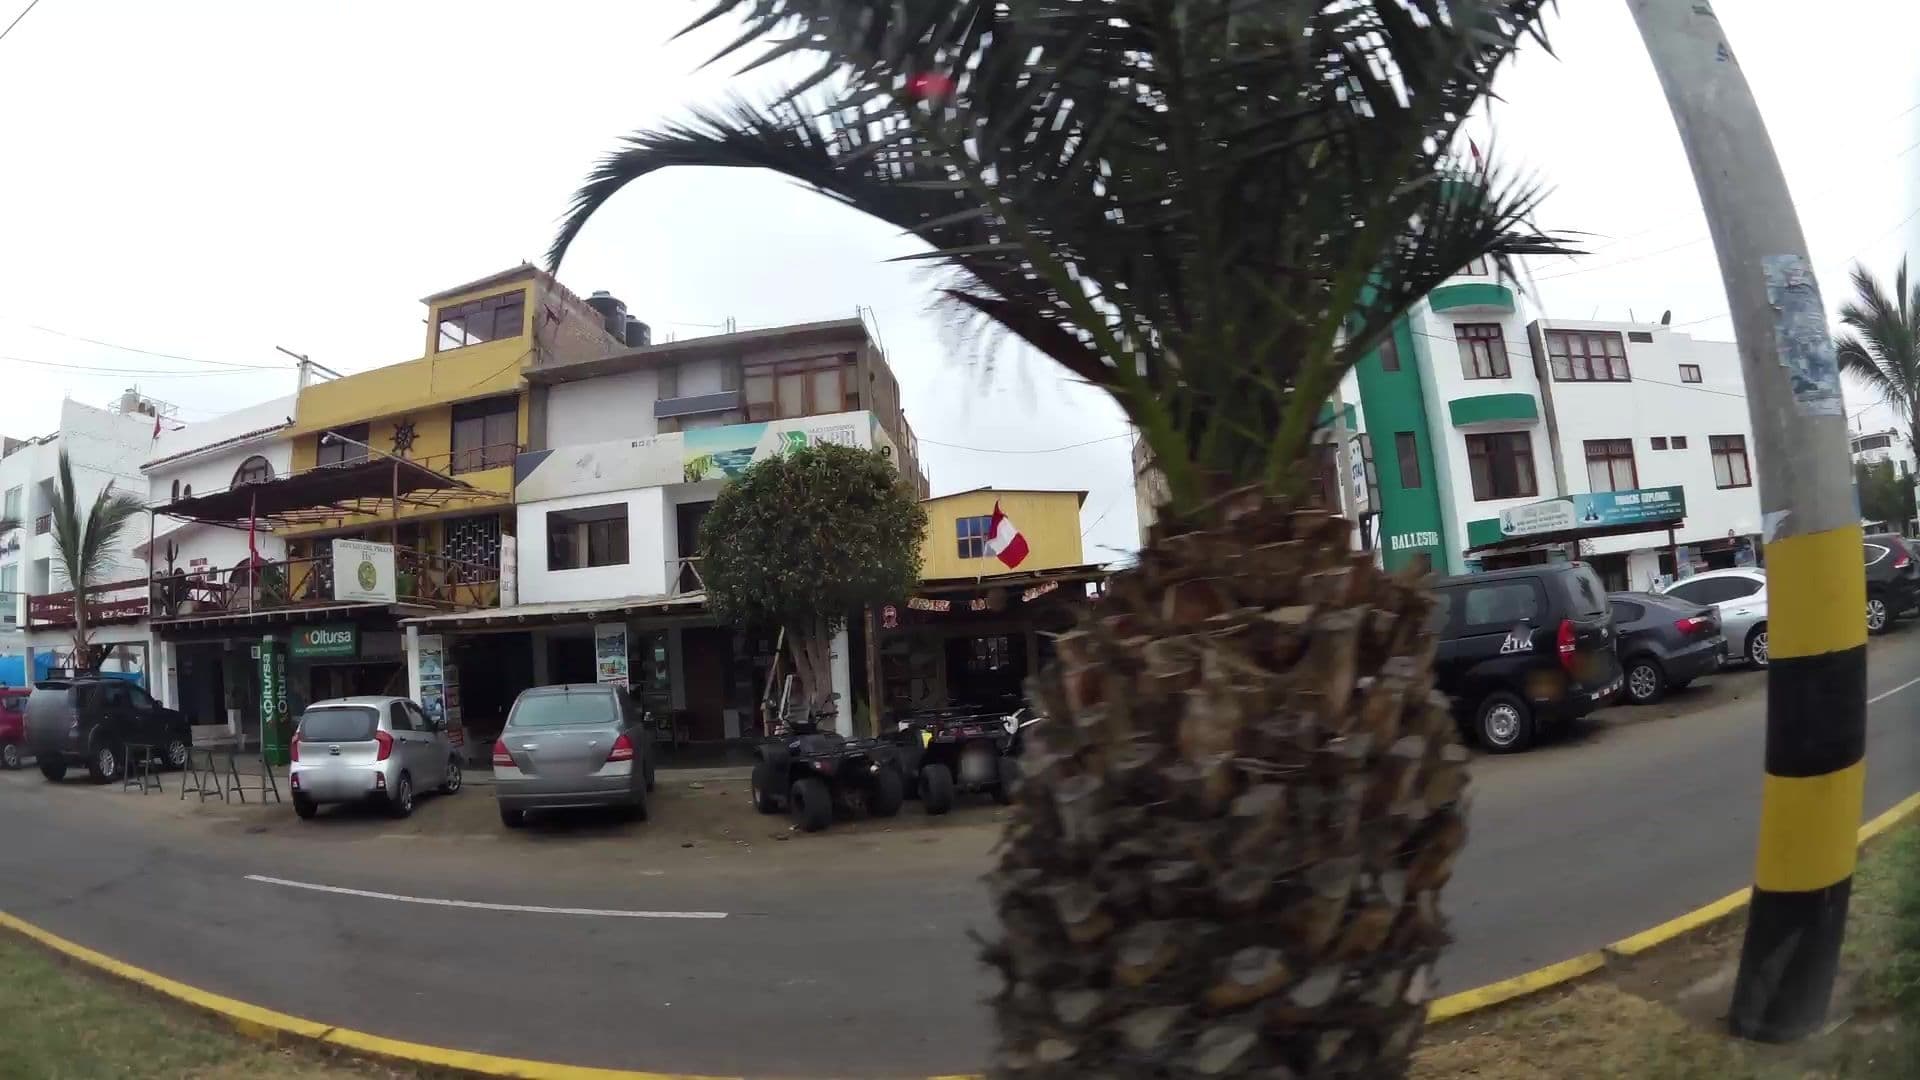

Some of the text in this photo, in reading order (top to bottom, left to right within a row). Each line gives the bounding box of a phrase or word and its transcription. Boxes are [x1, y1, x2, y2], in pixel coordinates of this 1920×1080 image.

[310, 629, 352, 645] Oltursa
[262, 653, 274, 715] Oltursa
[276, 653, 288, 715] Oltursa
